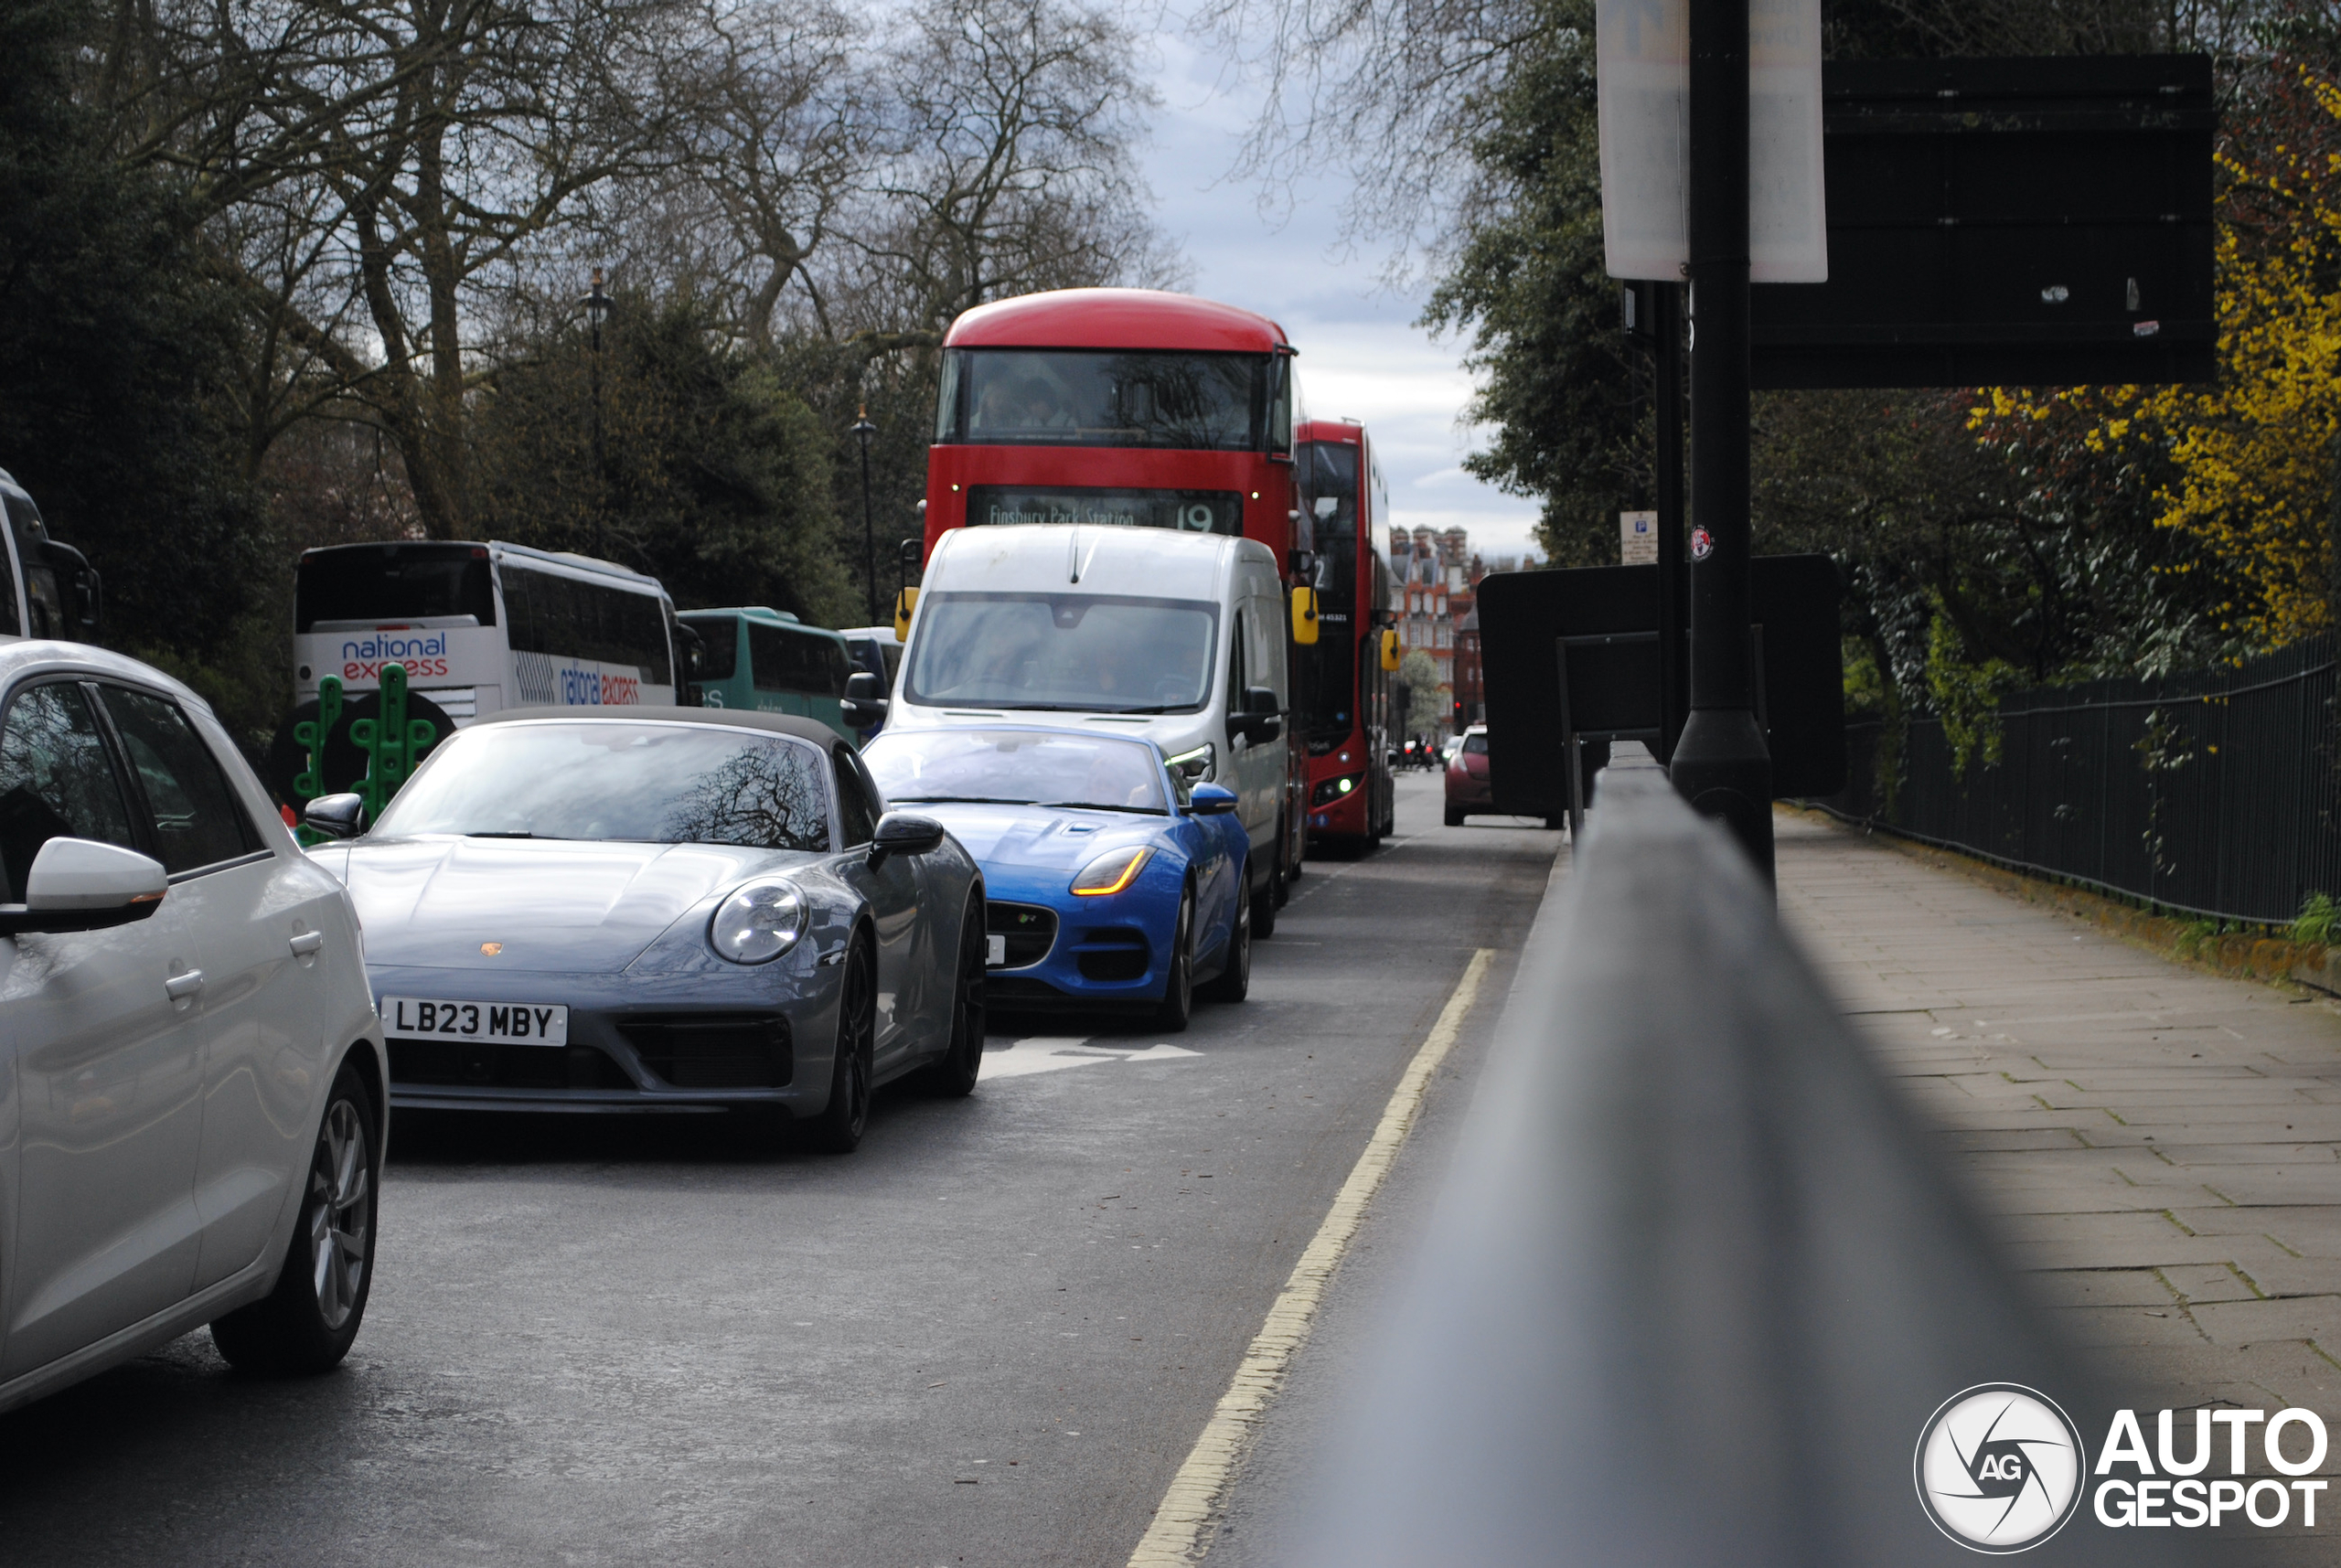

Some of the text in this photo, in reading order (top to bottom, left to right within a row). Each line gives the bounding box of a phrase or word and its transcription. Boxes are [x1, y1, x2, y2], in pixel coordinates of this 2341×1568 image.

[990, 505, 1134, 526] Finsbury Park Station
[1177, 504, 1213, 532] 19
[343, 632, 446, 658] national
[561, 659, 639, 705] national express
[397, 1001, 553, 1038] LB23 MBY
